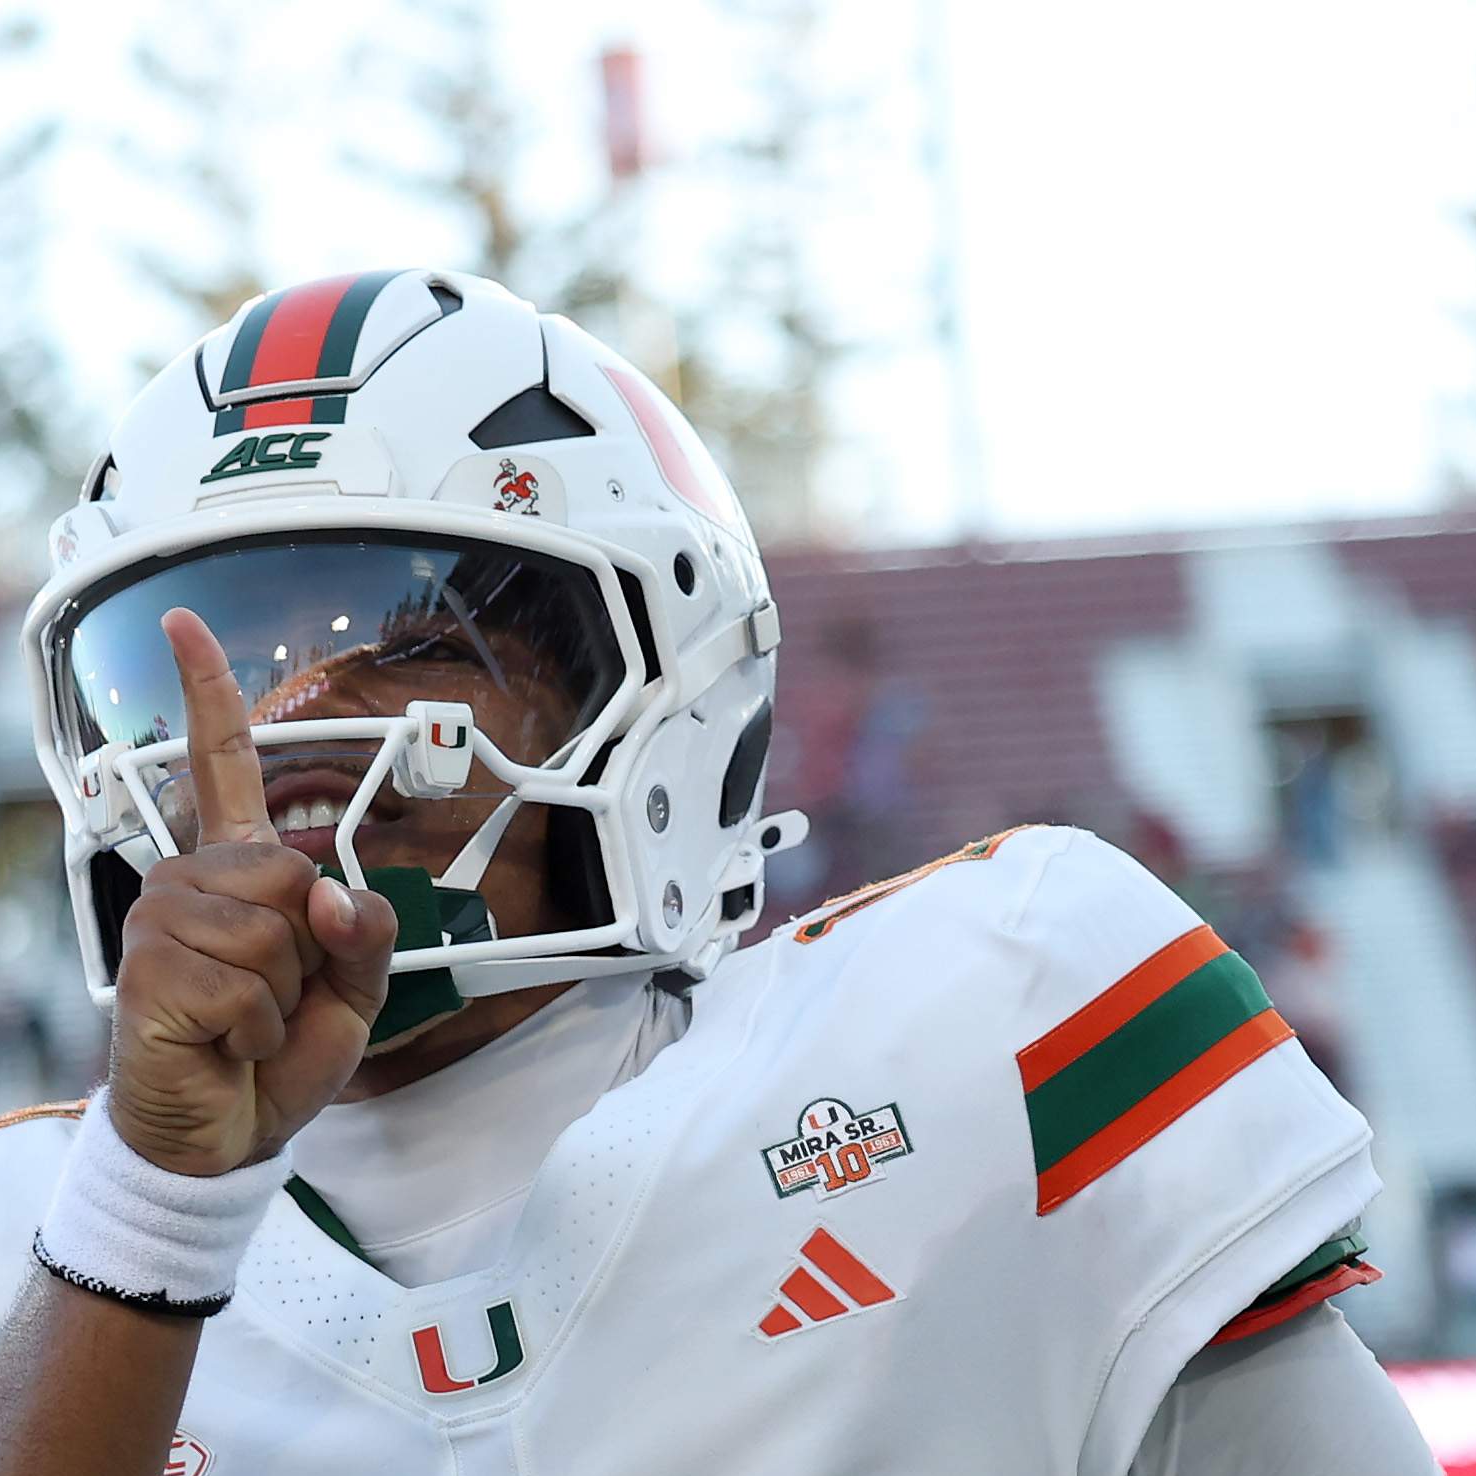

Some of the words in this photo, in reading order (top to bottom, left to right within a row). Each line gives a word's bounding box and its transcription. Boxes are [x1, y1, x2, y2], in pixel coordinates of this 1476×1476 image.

[206, 432, 332, 477] ACC
[431, 722, 466, 749] U
[778, 1130, 843, 1166] MIRA
[844, 1117, 885, 1141] SR.
[814, 1142, 872, 1193] 10
[411, 1300, 524, 1394] U
